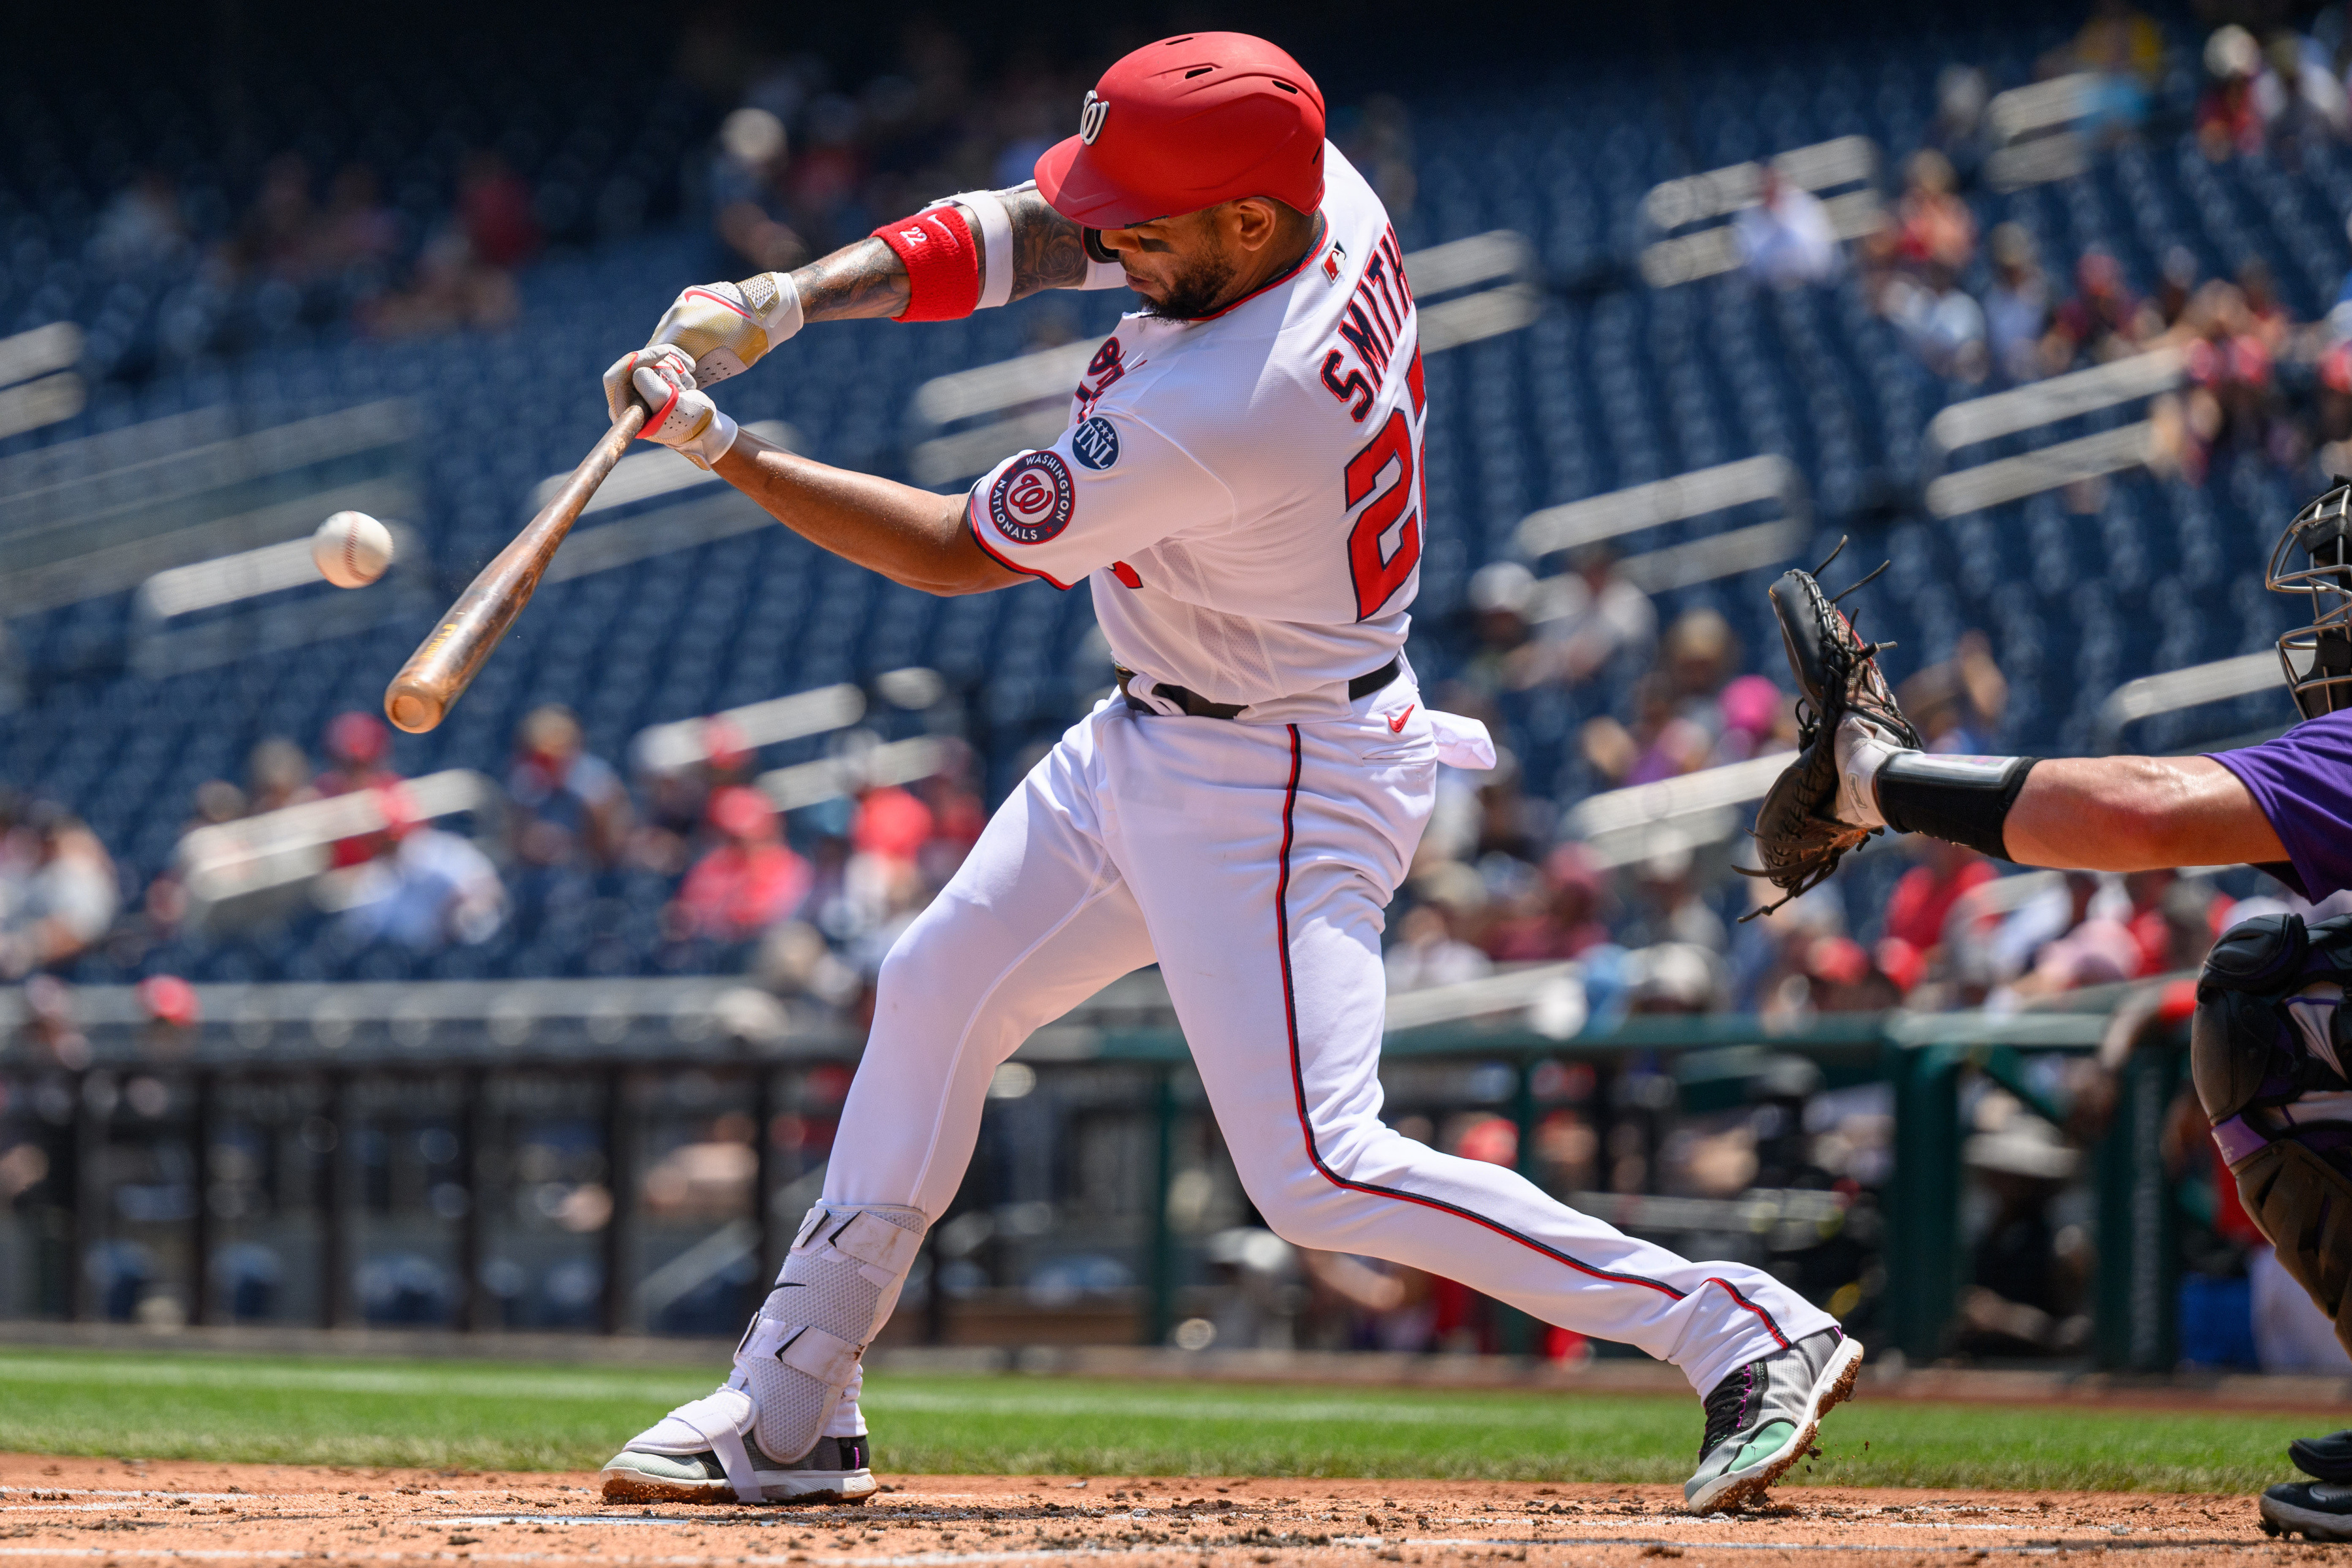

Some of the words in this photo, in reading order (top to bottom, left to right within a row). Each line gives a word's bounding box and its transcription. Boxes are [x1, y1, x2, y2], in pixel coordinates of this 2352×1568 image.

[900, 226, 928, 247] 22
[1320, 222, 1413, 422] SMITH
[1075, 420, 1114, 470] TNL
[992, 479, 1038, 540] NATIONALS
[1009, 474, 1054, 514] W
[1026, 454, 1070, 522] WASHINGTON
